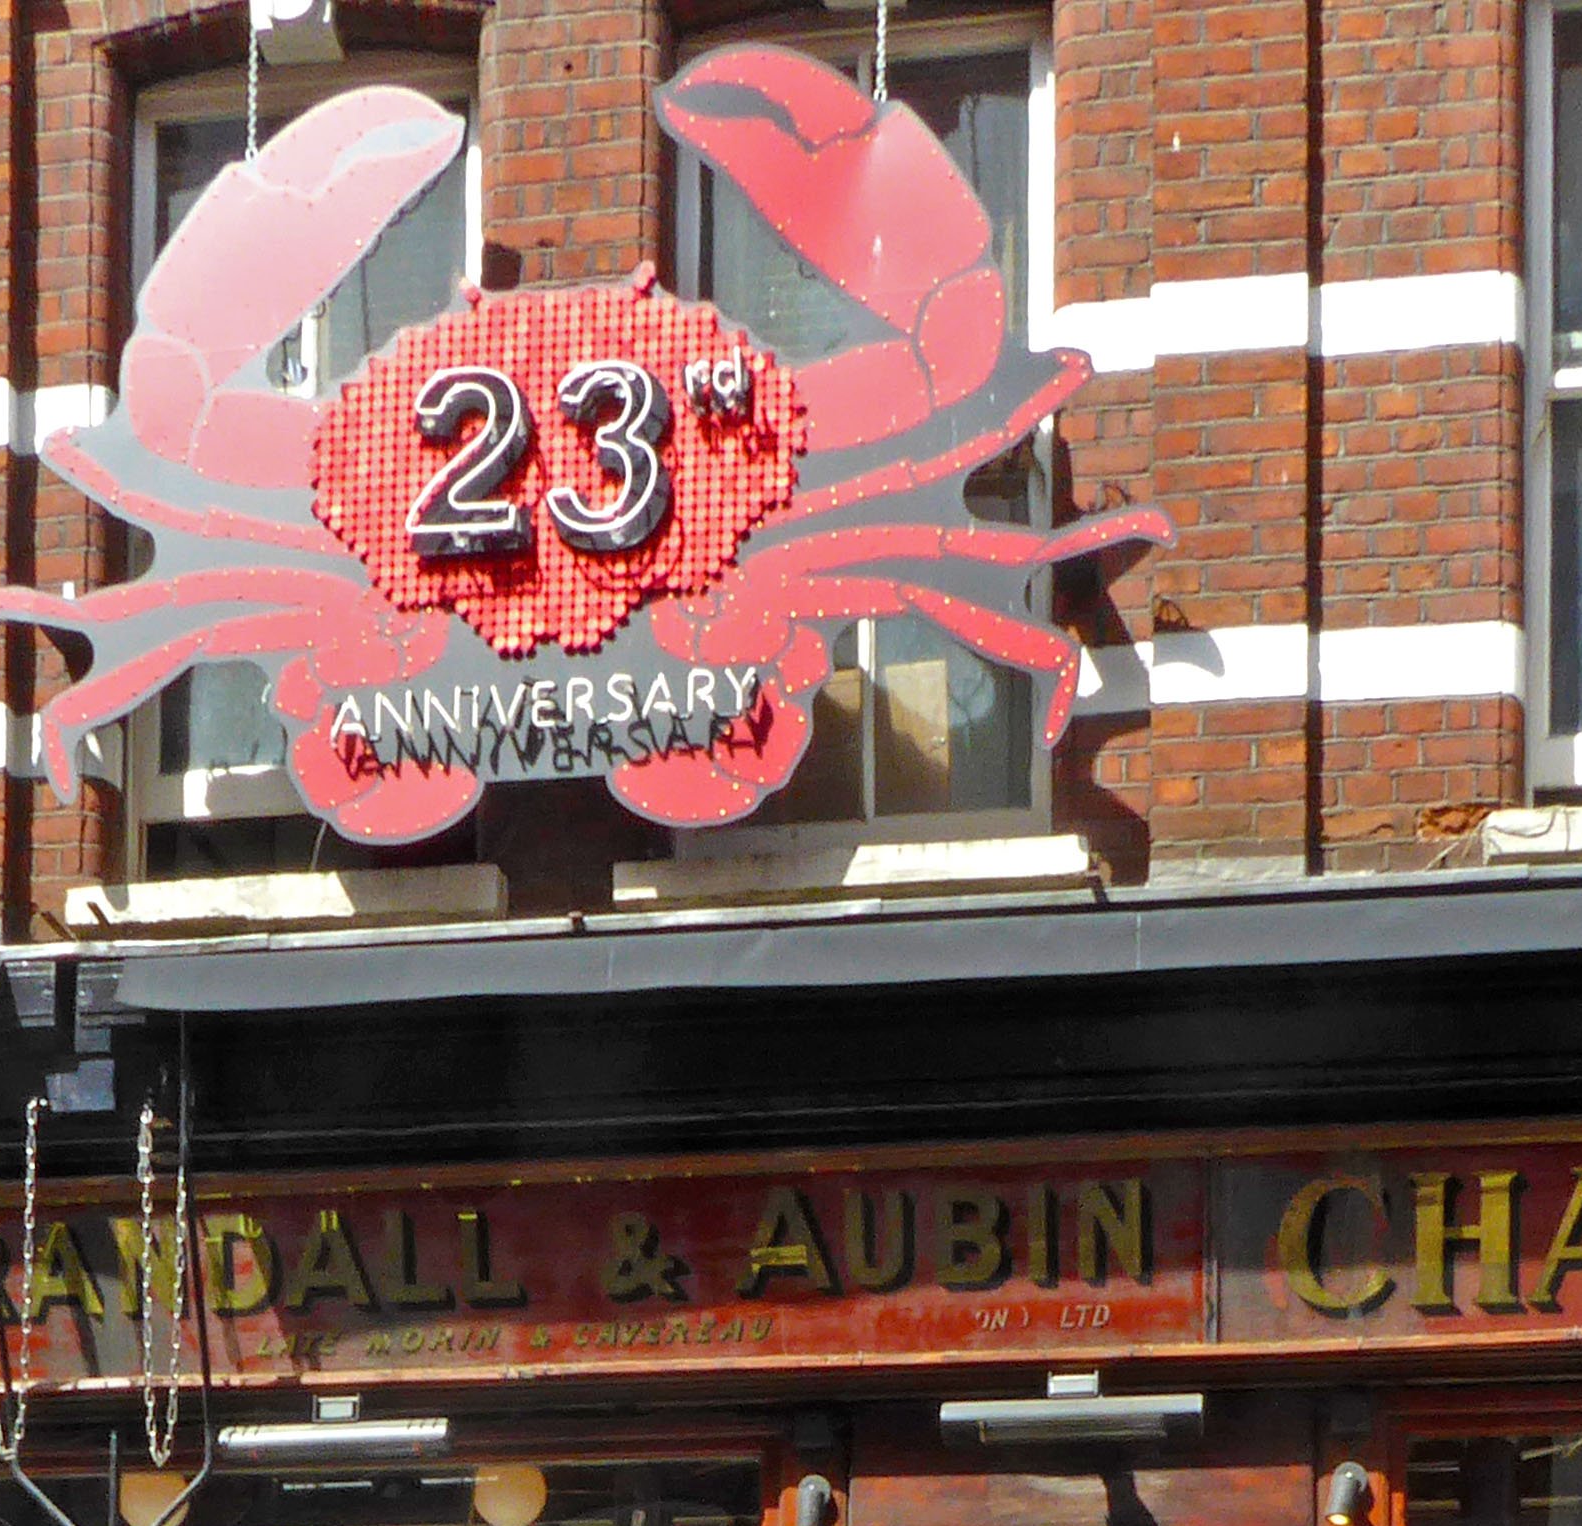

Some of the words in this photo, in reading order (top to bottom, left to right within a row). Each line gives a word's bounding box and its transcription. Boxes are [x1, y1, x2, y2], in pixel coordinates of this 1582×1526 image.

[331, 667, 758, 746] ANNIVERSARY
[601, 1210, 691, 1301] &
[735, 1178, 1155, 1300] AUBIN
[1059, 1304, 1112, 1330] LTD
